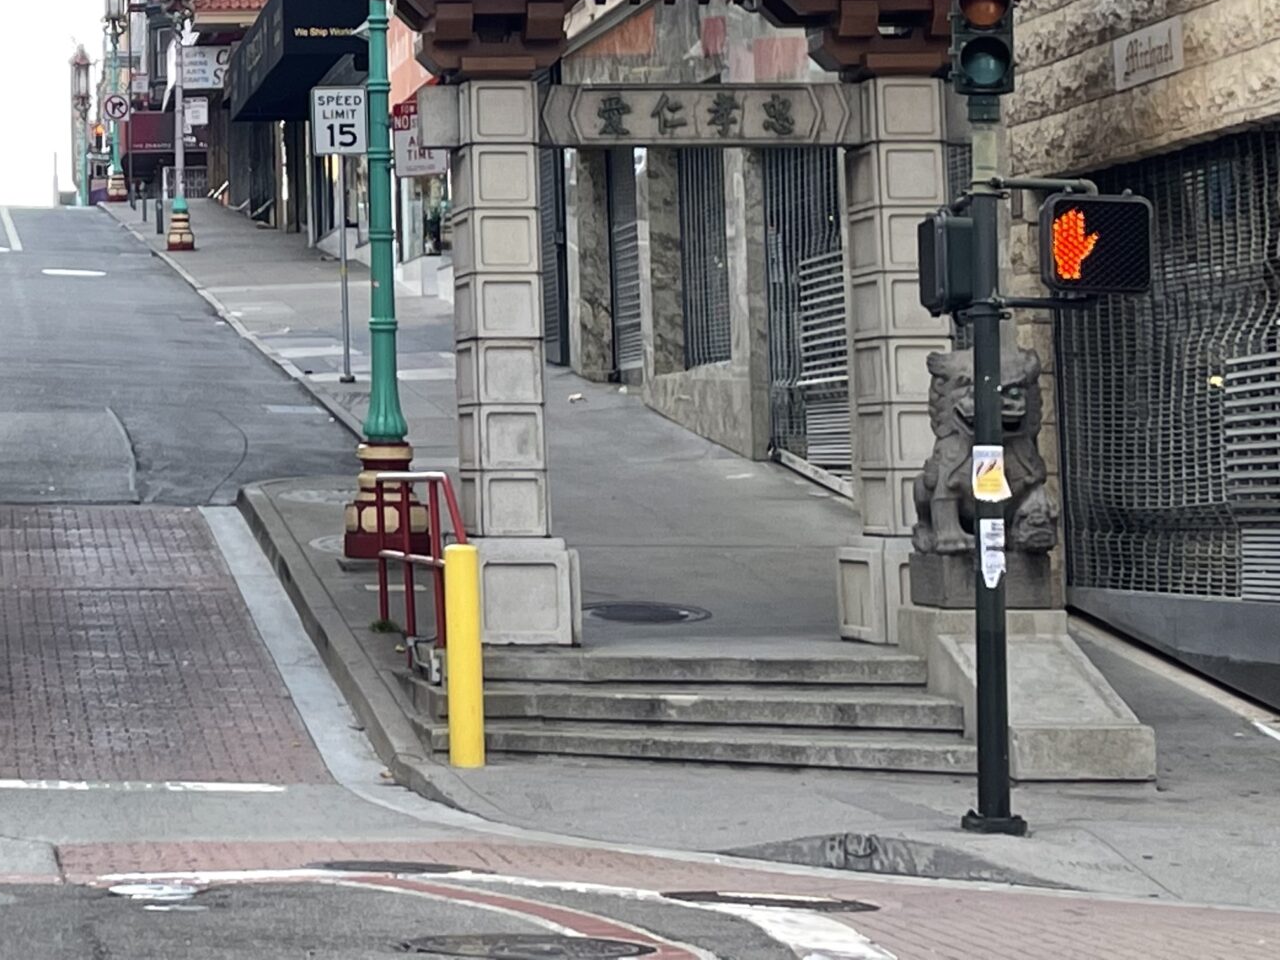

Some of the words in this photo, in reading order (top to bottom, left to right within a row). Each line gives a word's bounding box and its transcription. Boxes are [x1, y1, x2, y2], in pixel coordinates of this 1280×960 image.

[309, 27, 328, 38] Ship
[317, 95, 362, 107] SPEED
[322, 109, 357, 121] LIMIT
[393, 115, 409, 129] NO
[326, 123, 357, 148] 15
[406, 148, 435, 161] TIME
